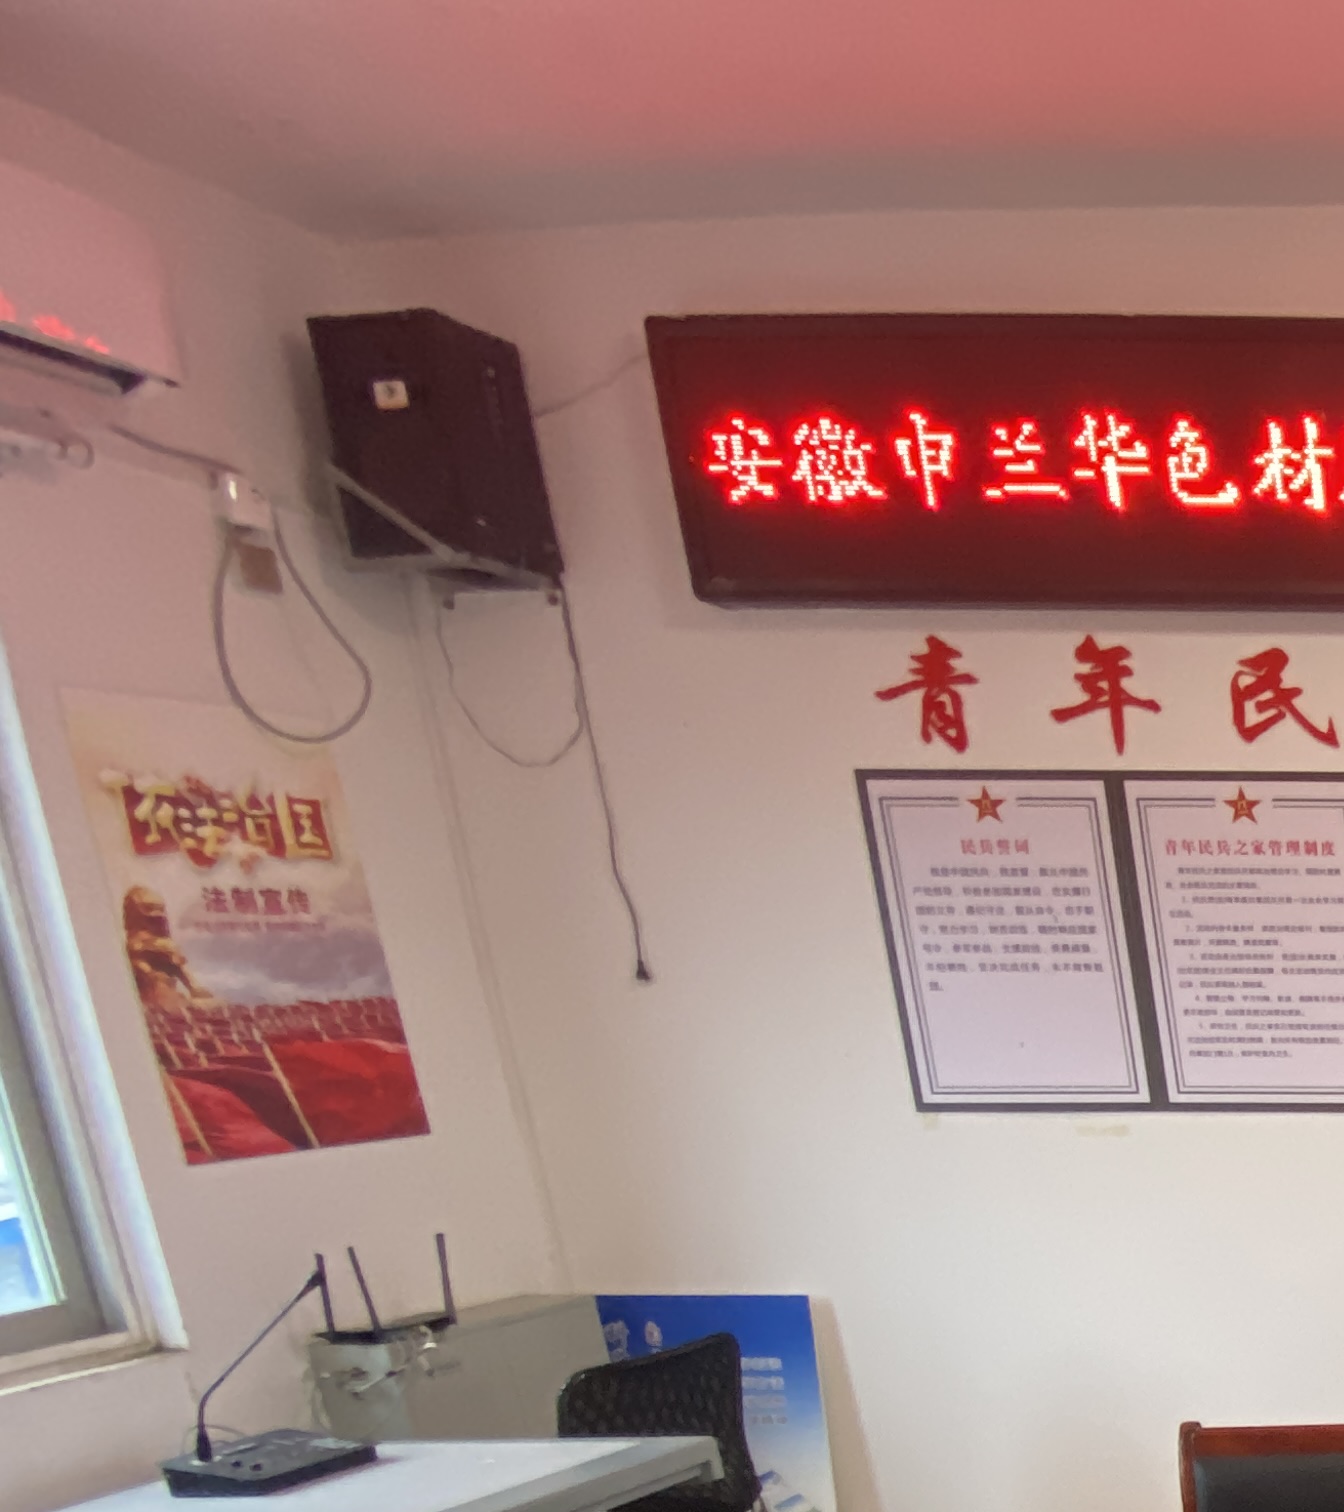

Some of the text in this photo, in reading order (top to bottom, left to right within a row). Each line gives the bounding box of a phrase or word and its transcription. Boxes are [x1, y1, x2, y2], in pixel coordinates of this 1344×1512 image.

[1166, 839, 1336, 857] 青年民兵之家管理制度
